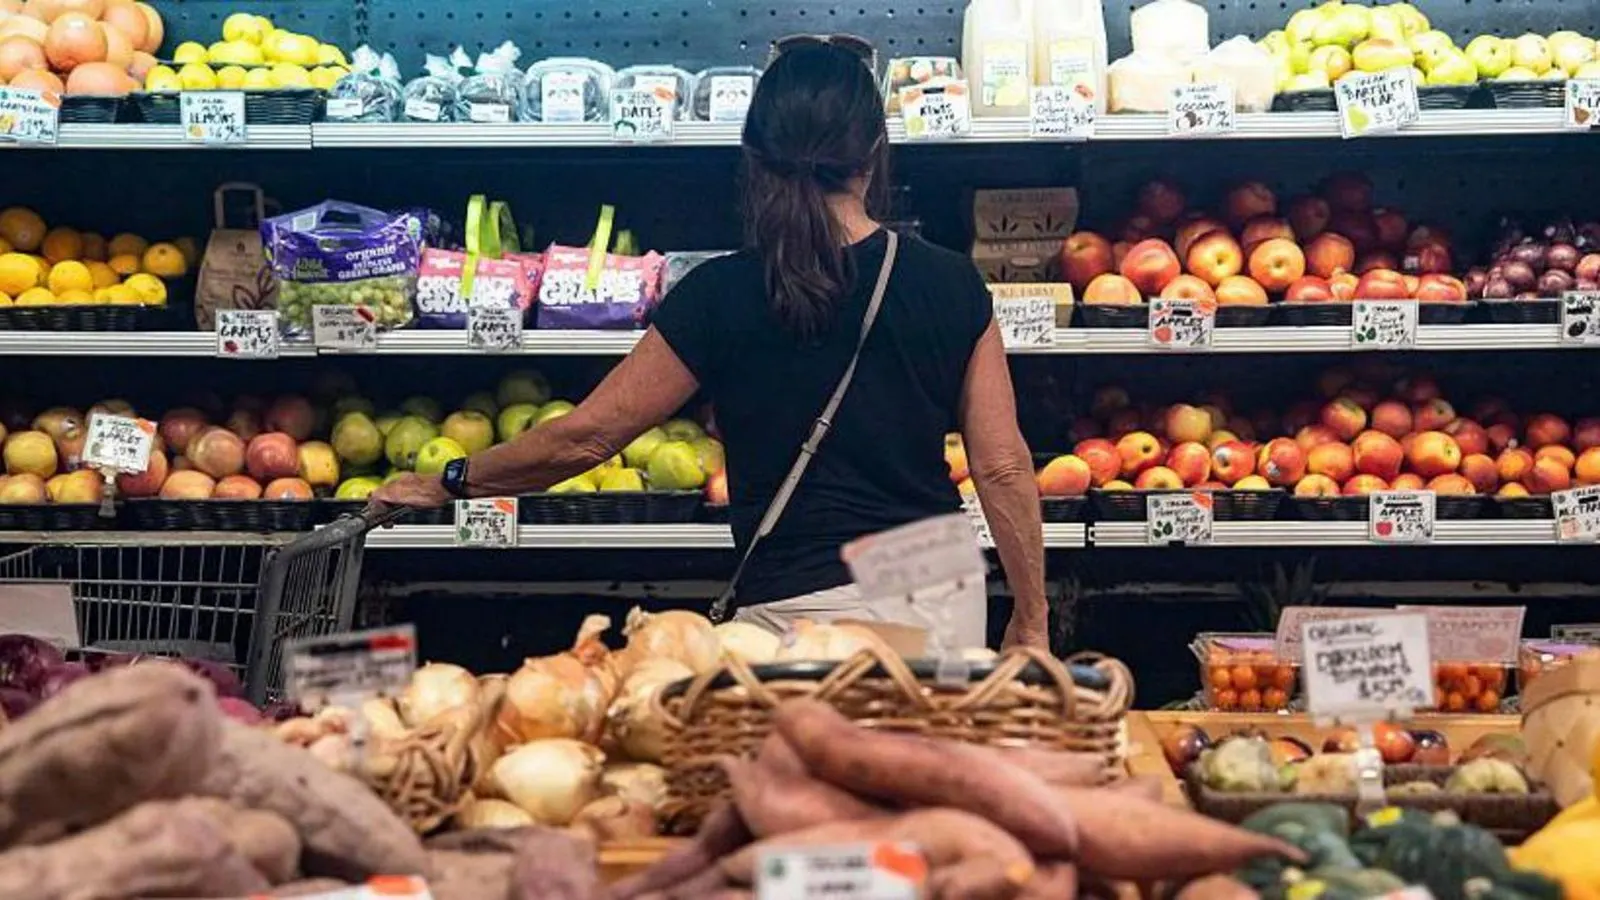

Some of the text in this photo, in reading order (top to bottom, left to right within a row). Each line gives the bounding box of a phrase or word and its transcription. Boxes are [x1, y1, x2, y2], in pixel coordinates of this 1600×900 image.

[346, 244, 397, 262] organic
[472, 321, 516, 333] GRAPES
[1155, 316, 1204, 327] APPLES
[221, 326, 272, 341] GRAPES
[98, 431, 142, 445] APPLES
[1379, 508, 1426, 518] APPLES
[466, 516, 506, 528] APPLES
